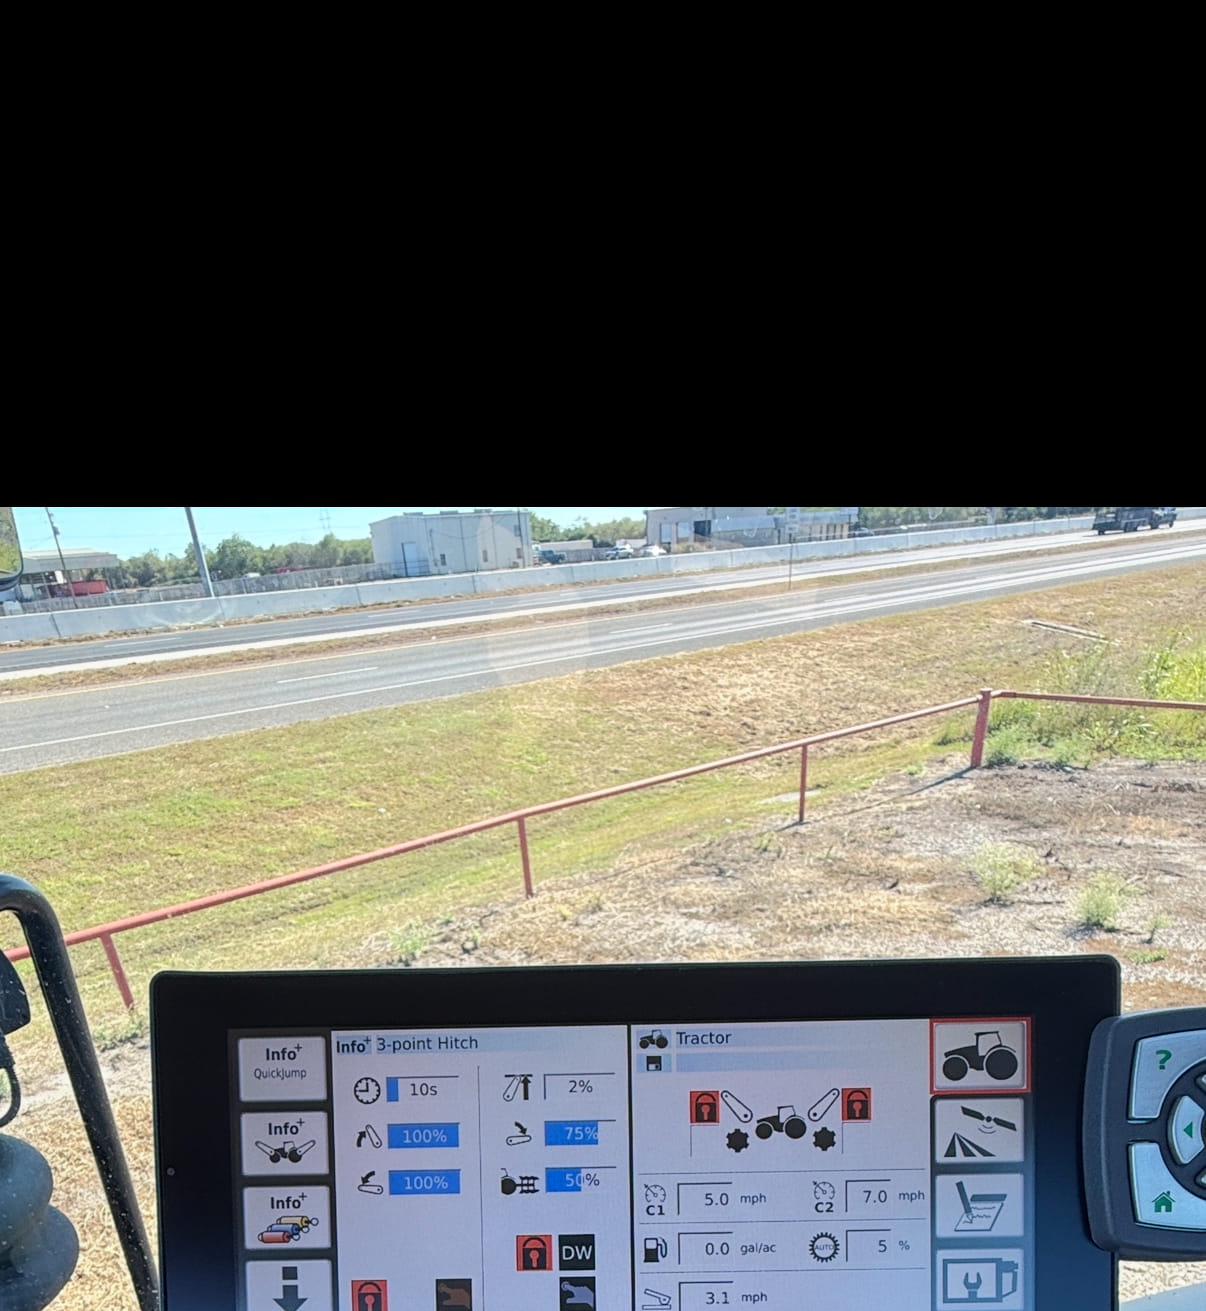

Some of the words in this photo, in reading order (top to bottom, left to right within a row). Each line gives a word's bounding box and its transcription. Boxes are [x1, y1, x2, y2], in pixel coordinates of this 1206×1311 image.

[376, 1036, 433, 1052] 3-point
[438, 1036, 479, 1050] Hitch
[676, 1031, 733, 1045] Tractor
[254, 1067, 307, 1080] QuickJump
[410, 1083, 438, 1097] 10s
[568, 1080, 593, 1094] 2%
[402, 1129, 447, 1144] 100%
[565, 1126, 599, 1141] 75%
[403, 1175, 449, 1190] 100%
[565, 1173, 600, 1188] 50%
[704, 1193, 729, 1207] 5.0
[740, 1193, 767, 1206] mph
[862, 1190, 888, 1204] 7.0
[898, 1189, 926, 1203] mph
[646, 1205, 665, 1217] C1
[814, 1201, 834, 1213] C2
[562, 1245, 593, 1261] DW
[705, 1242, 730, 1256] 0.0
[740, 1241, 777, 1256] gal/ac
[877, 1240, 888, 1253] 5
[898, 1240, 911, 1252] %
[705, 1291, 730, 1305] 3.1
[741, 1291, 768, 1304] mph
